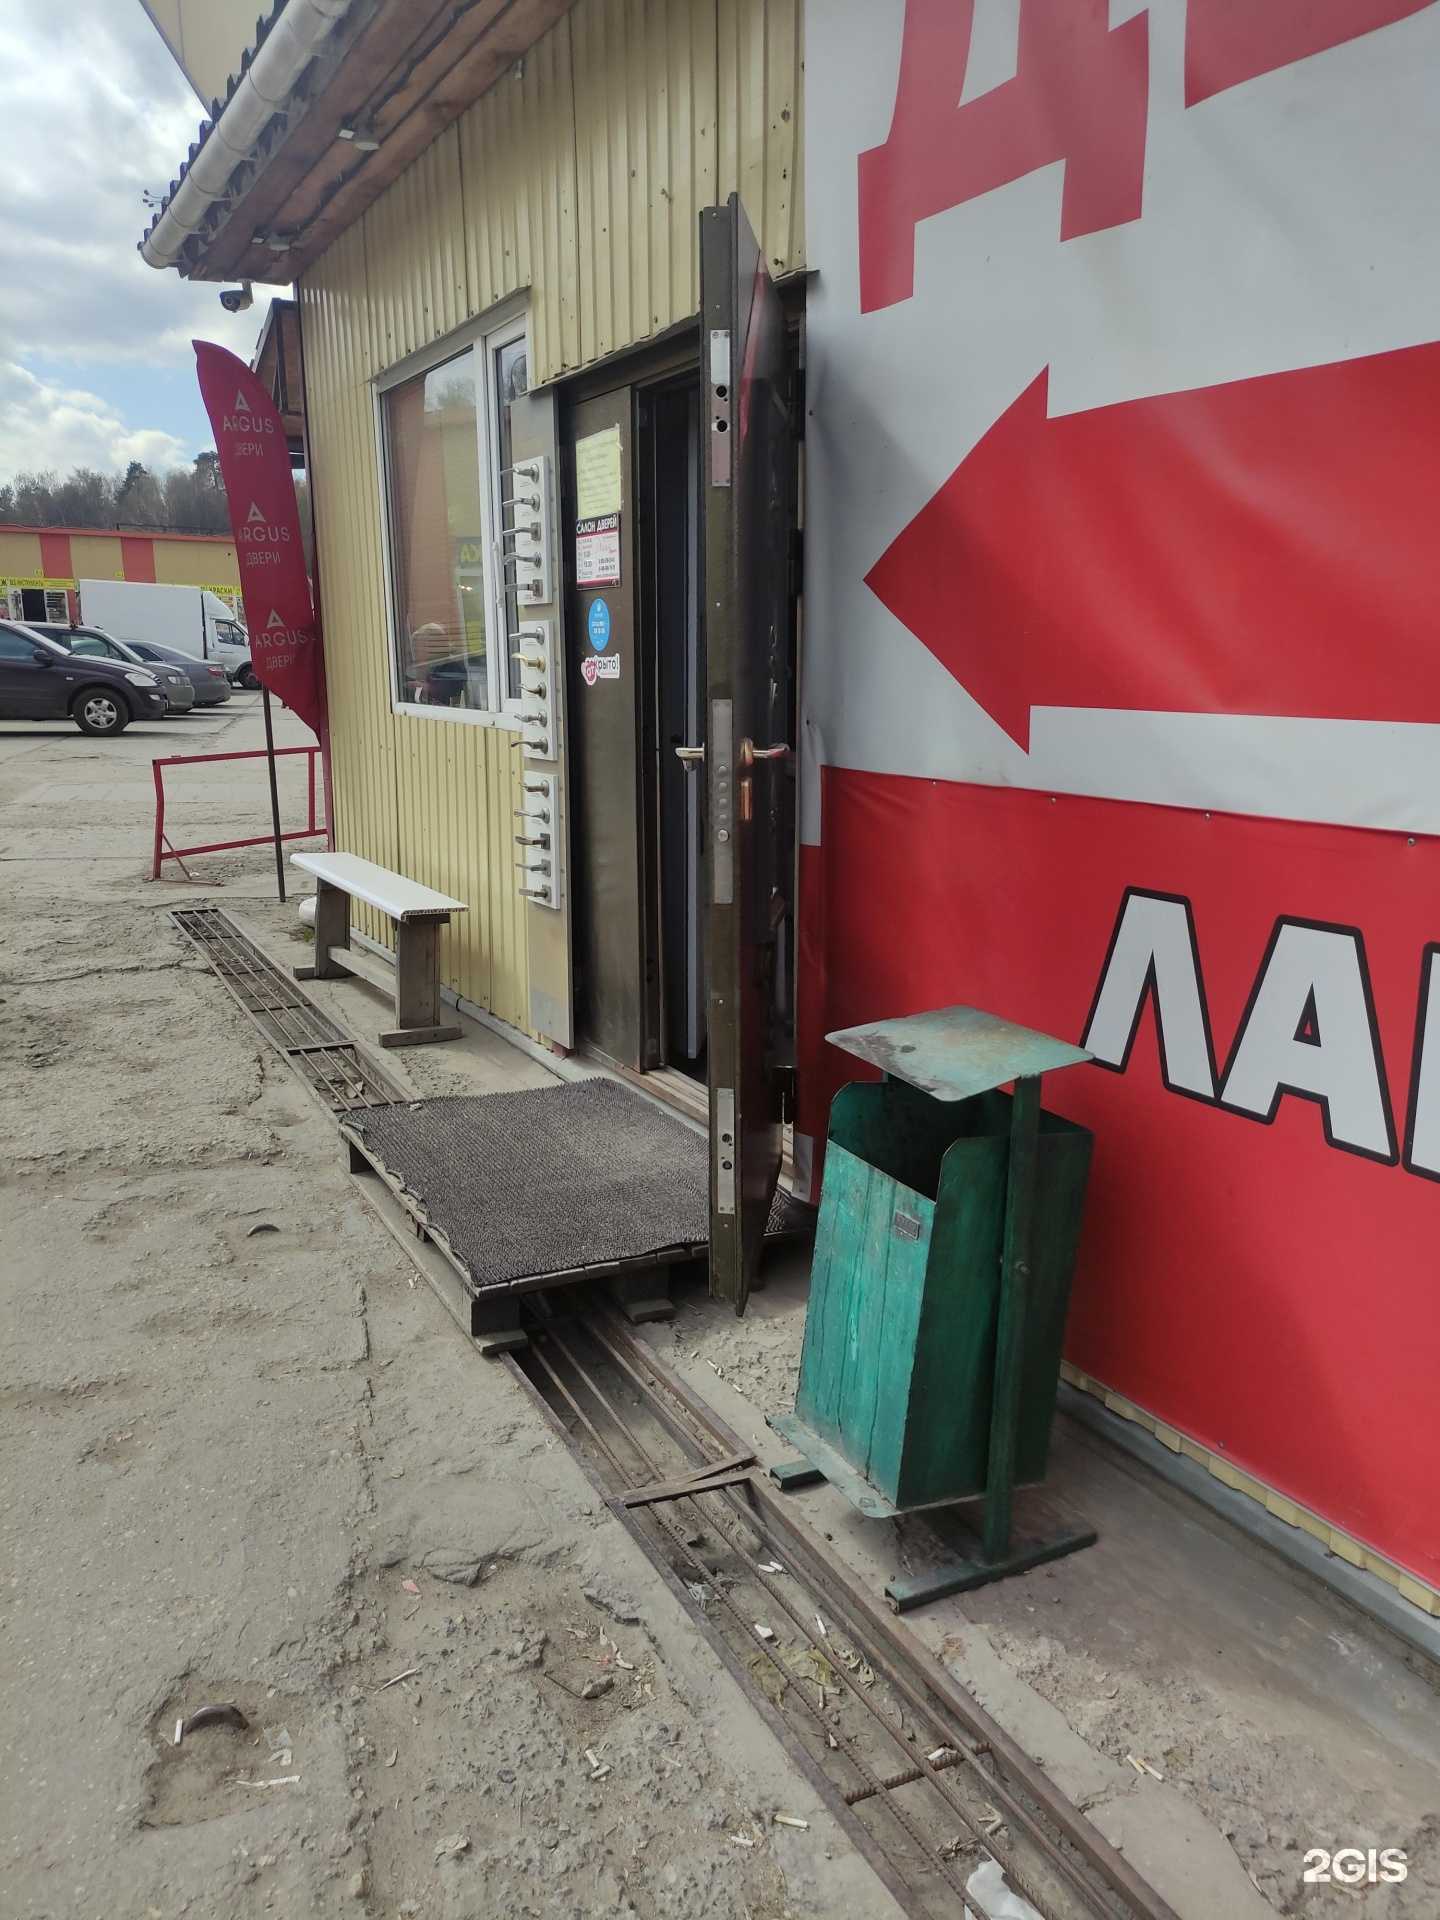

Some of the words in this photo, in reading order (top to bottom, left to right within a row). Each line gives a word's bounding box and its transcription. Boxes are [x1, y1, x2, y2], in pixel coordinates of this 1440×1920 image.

[223, 415, 274, 433] ARGUS
[255, 630, 309, 648] ARGUS
[1079, 885, 1440, 1184] ЛА
